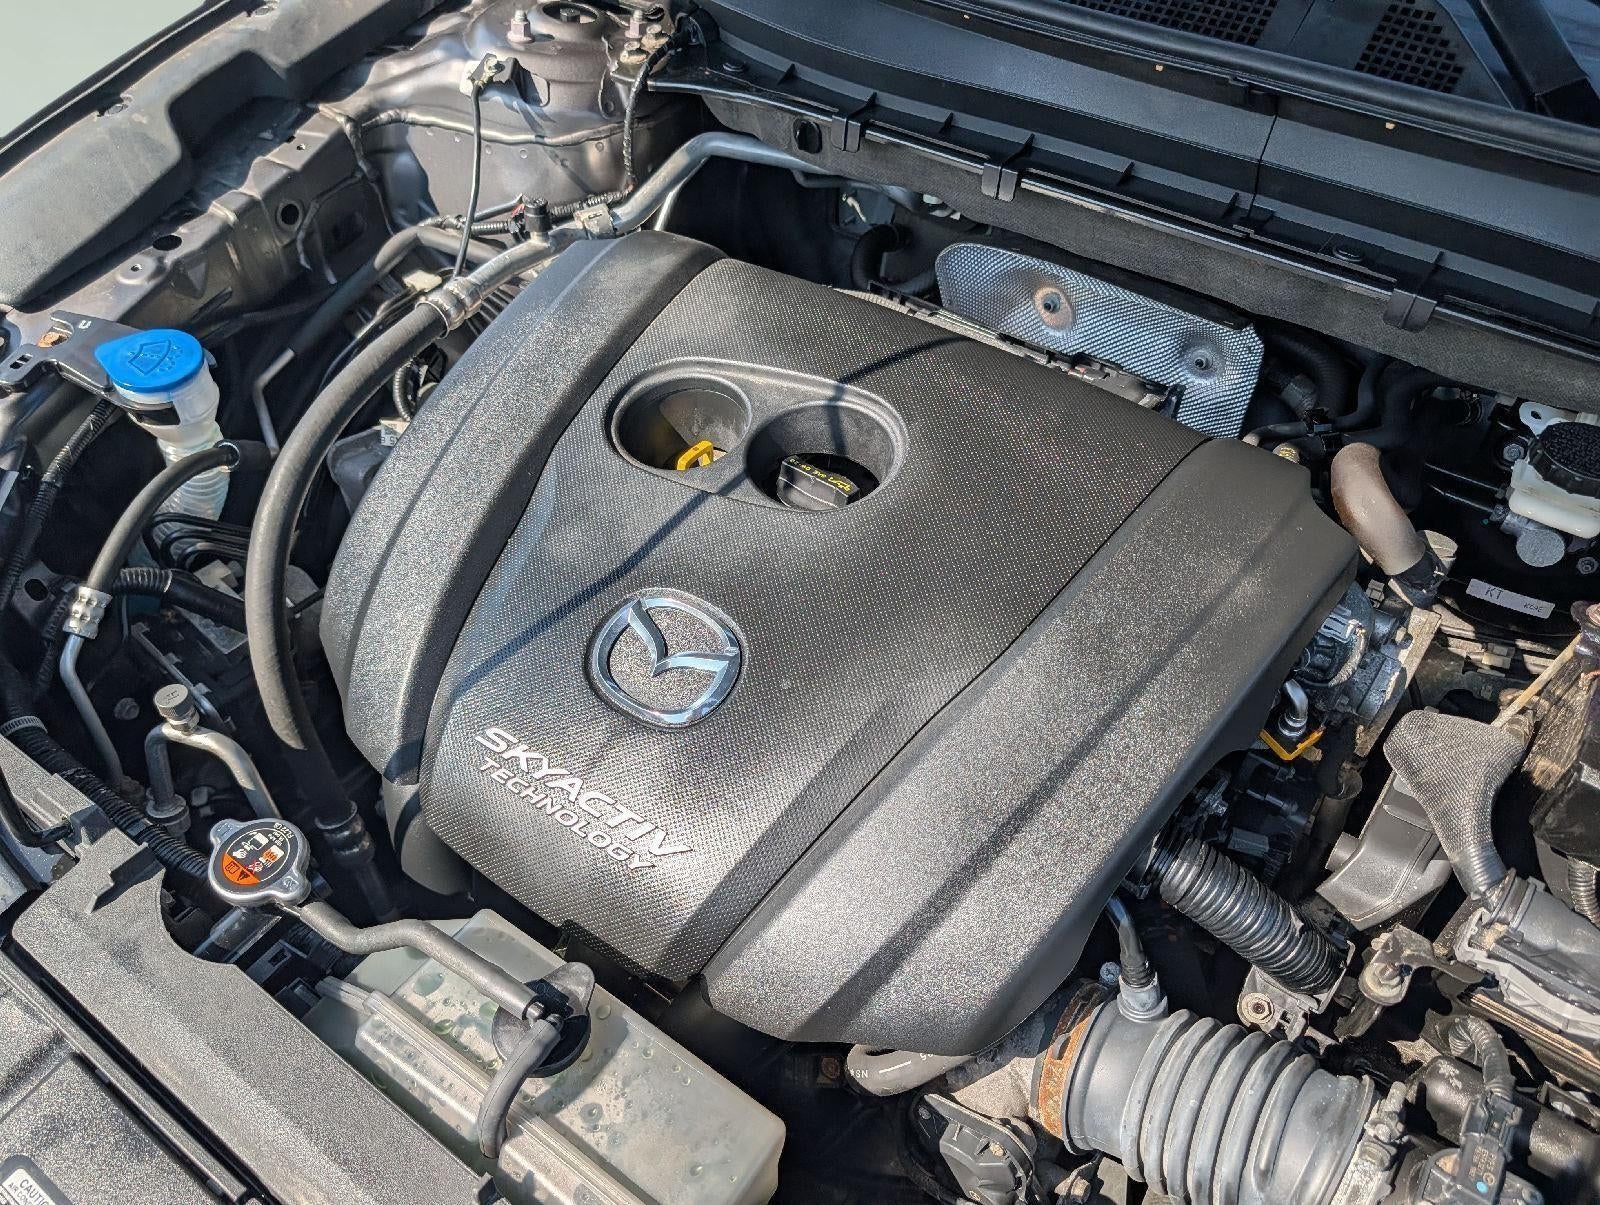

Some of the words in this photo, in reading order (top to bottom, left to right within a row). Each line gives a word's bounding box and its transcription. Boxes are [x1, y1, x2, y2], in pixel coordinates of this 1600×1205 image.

[1485, 586, 1503, 600] KT
[474, 727, 693, 857] SKYACTIV
[479, 756, 657, 871] TECHNOLOGY
[8, 1182, 19, 1193] AIR
